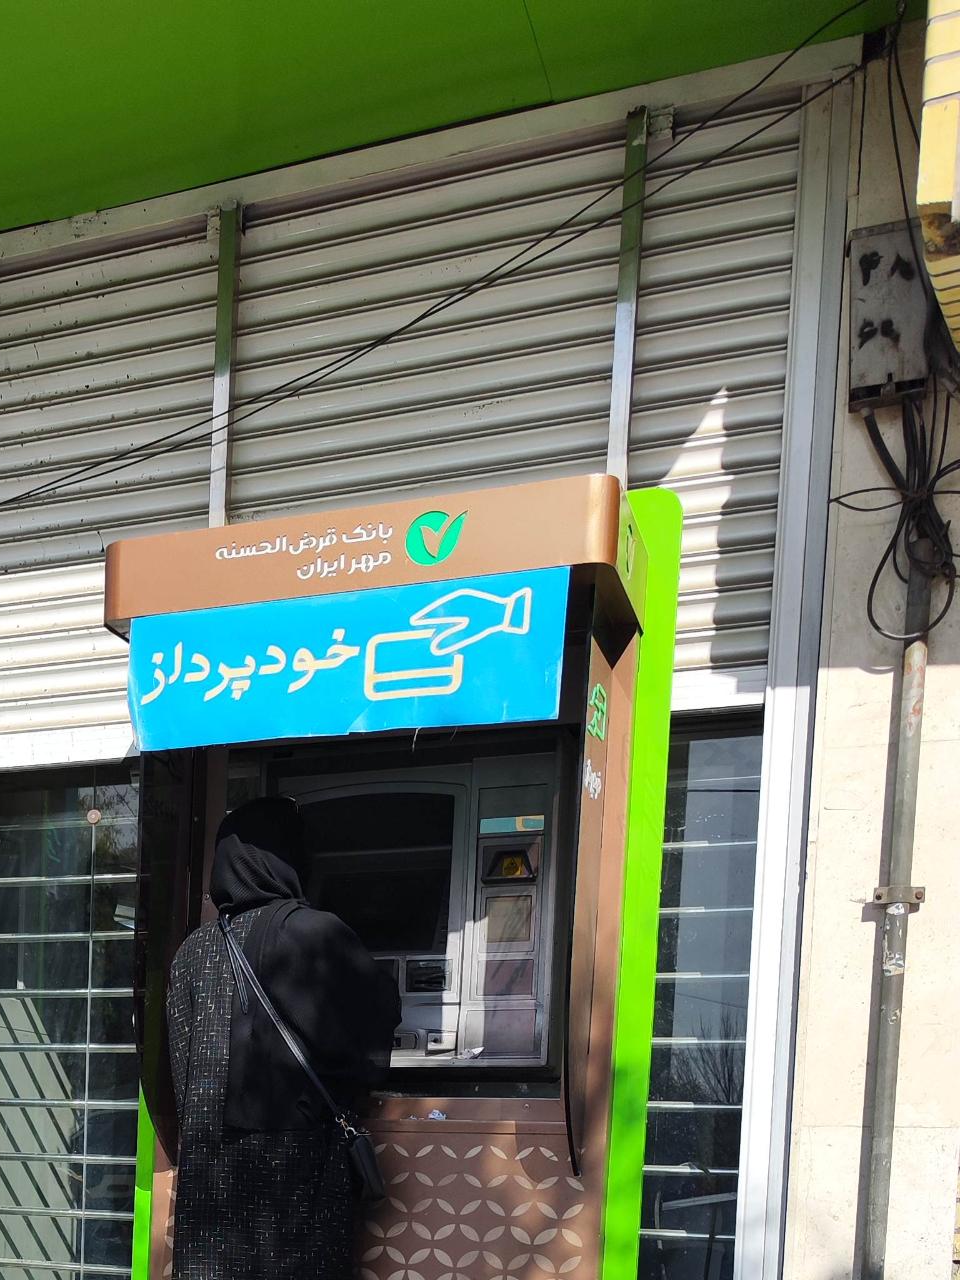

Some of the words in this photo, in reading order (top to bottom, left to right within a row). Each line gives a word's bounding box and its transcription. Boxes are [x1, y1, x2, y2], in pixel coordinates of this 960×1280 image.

[342, 521, 393, 544] بانک
[296, 554, 345, 580] ایران
[347, 550, 392, 574] مهر
[140, 628, 361, 706] خودپرداز
